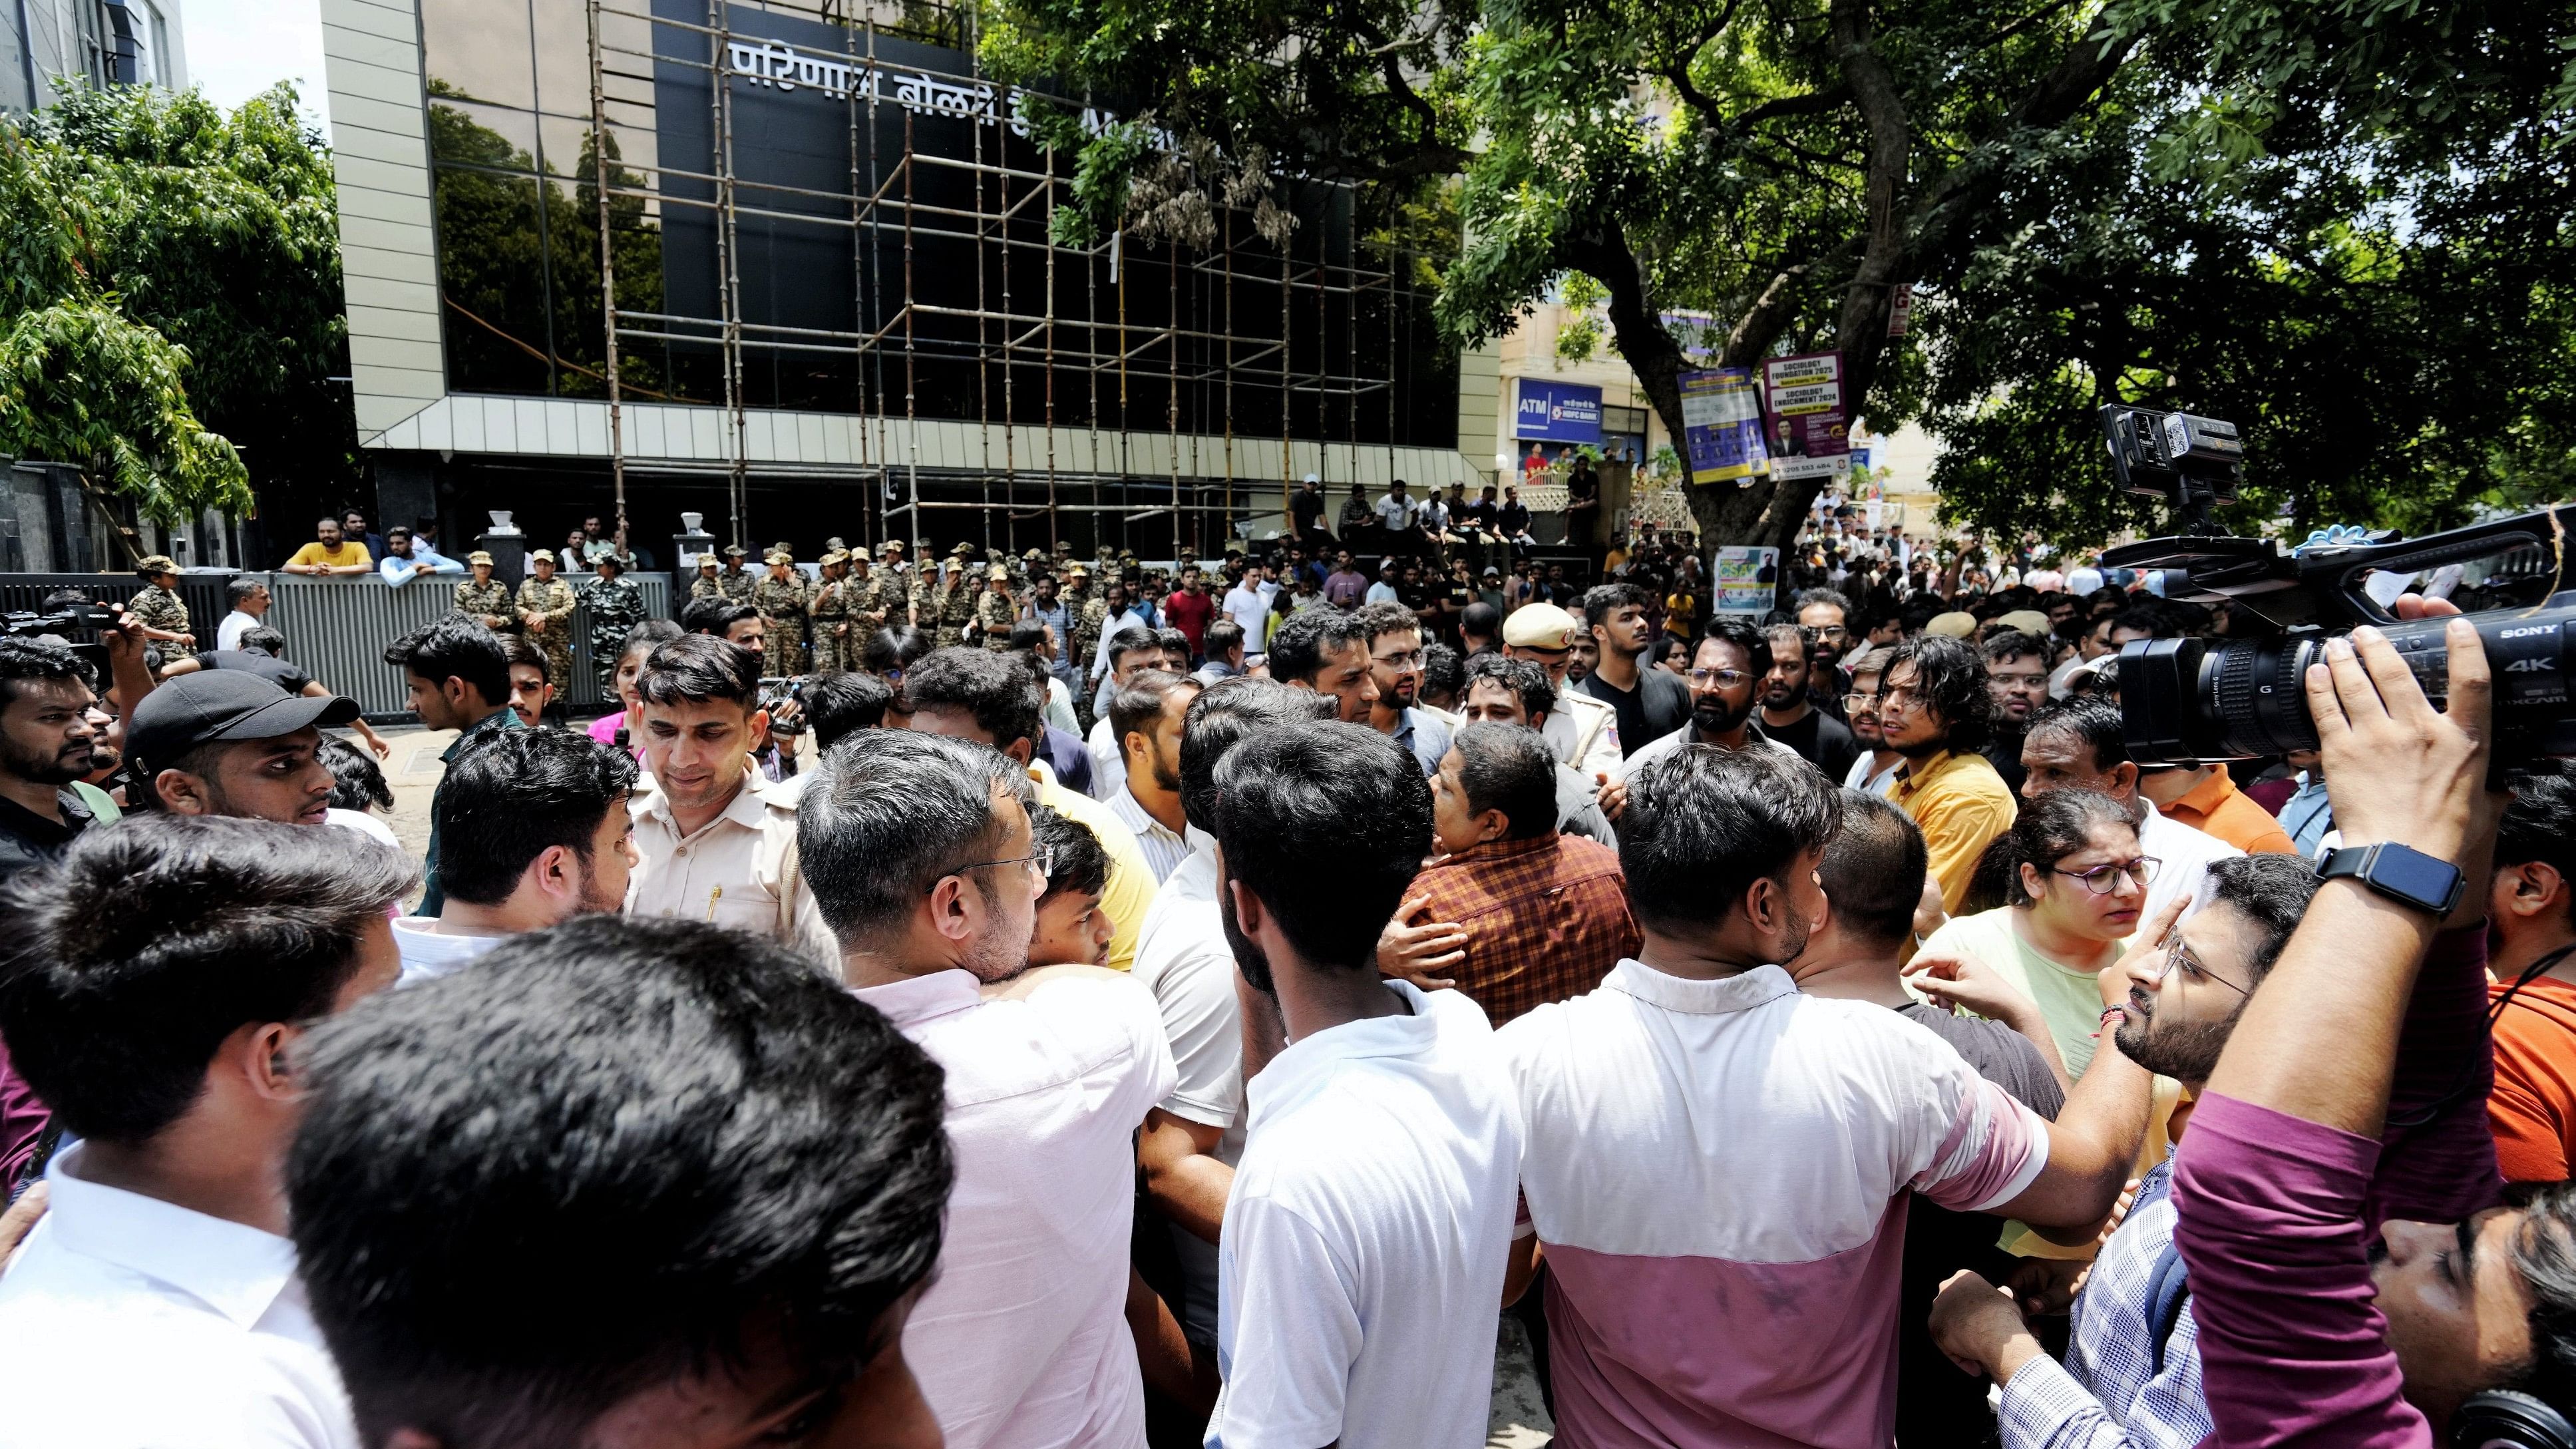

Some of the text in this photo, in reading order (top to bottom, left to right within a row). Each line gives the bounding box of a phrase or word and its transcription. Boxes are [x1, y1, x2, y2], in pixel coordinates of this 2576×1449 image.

[1783, 360, 1821, 371] SOCIOLOGY
[1772, 366, 1833, 379] FOUNDATION 2025
[1786, 387, 1823, 398] SOCIOLOGY
[1519, 399, 1547, 414] ATM
[1774, 396, 1817, 407] ENRICHMENT
[1562, 410, 1597, 421] HDFC BANK
[2500, 624, 2558, 639] SONY
[2504, 657, 2556, 672] 4K
